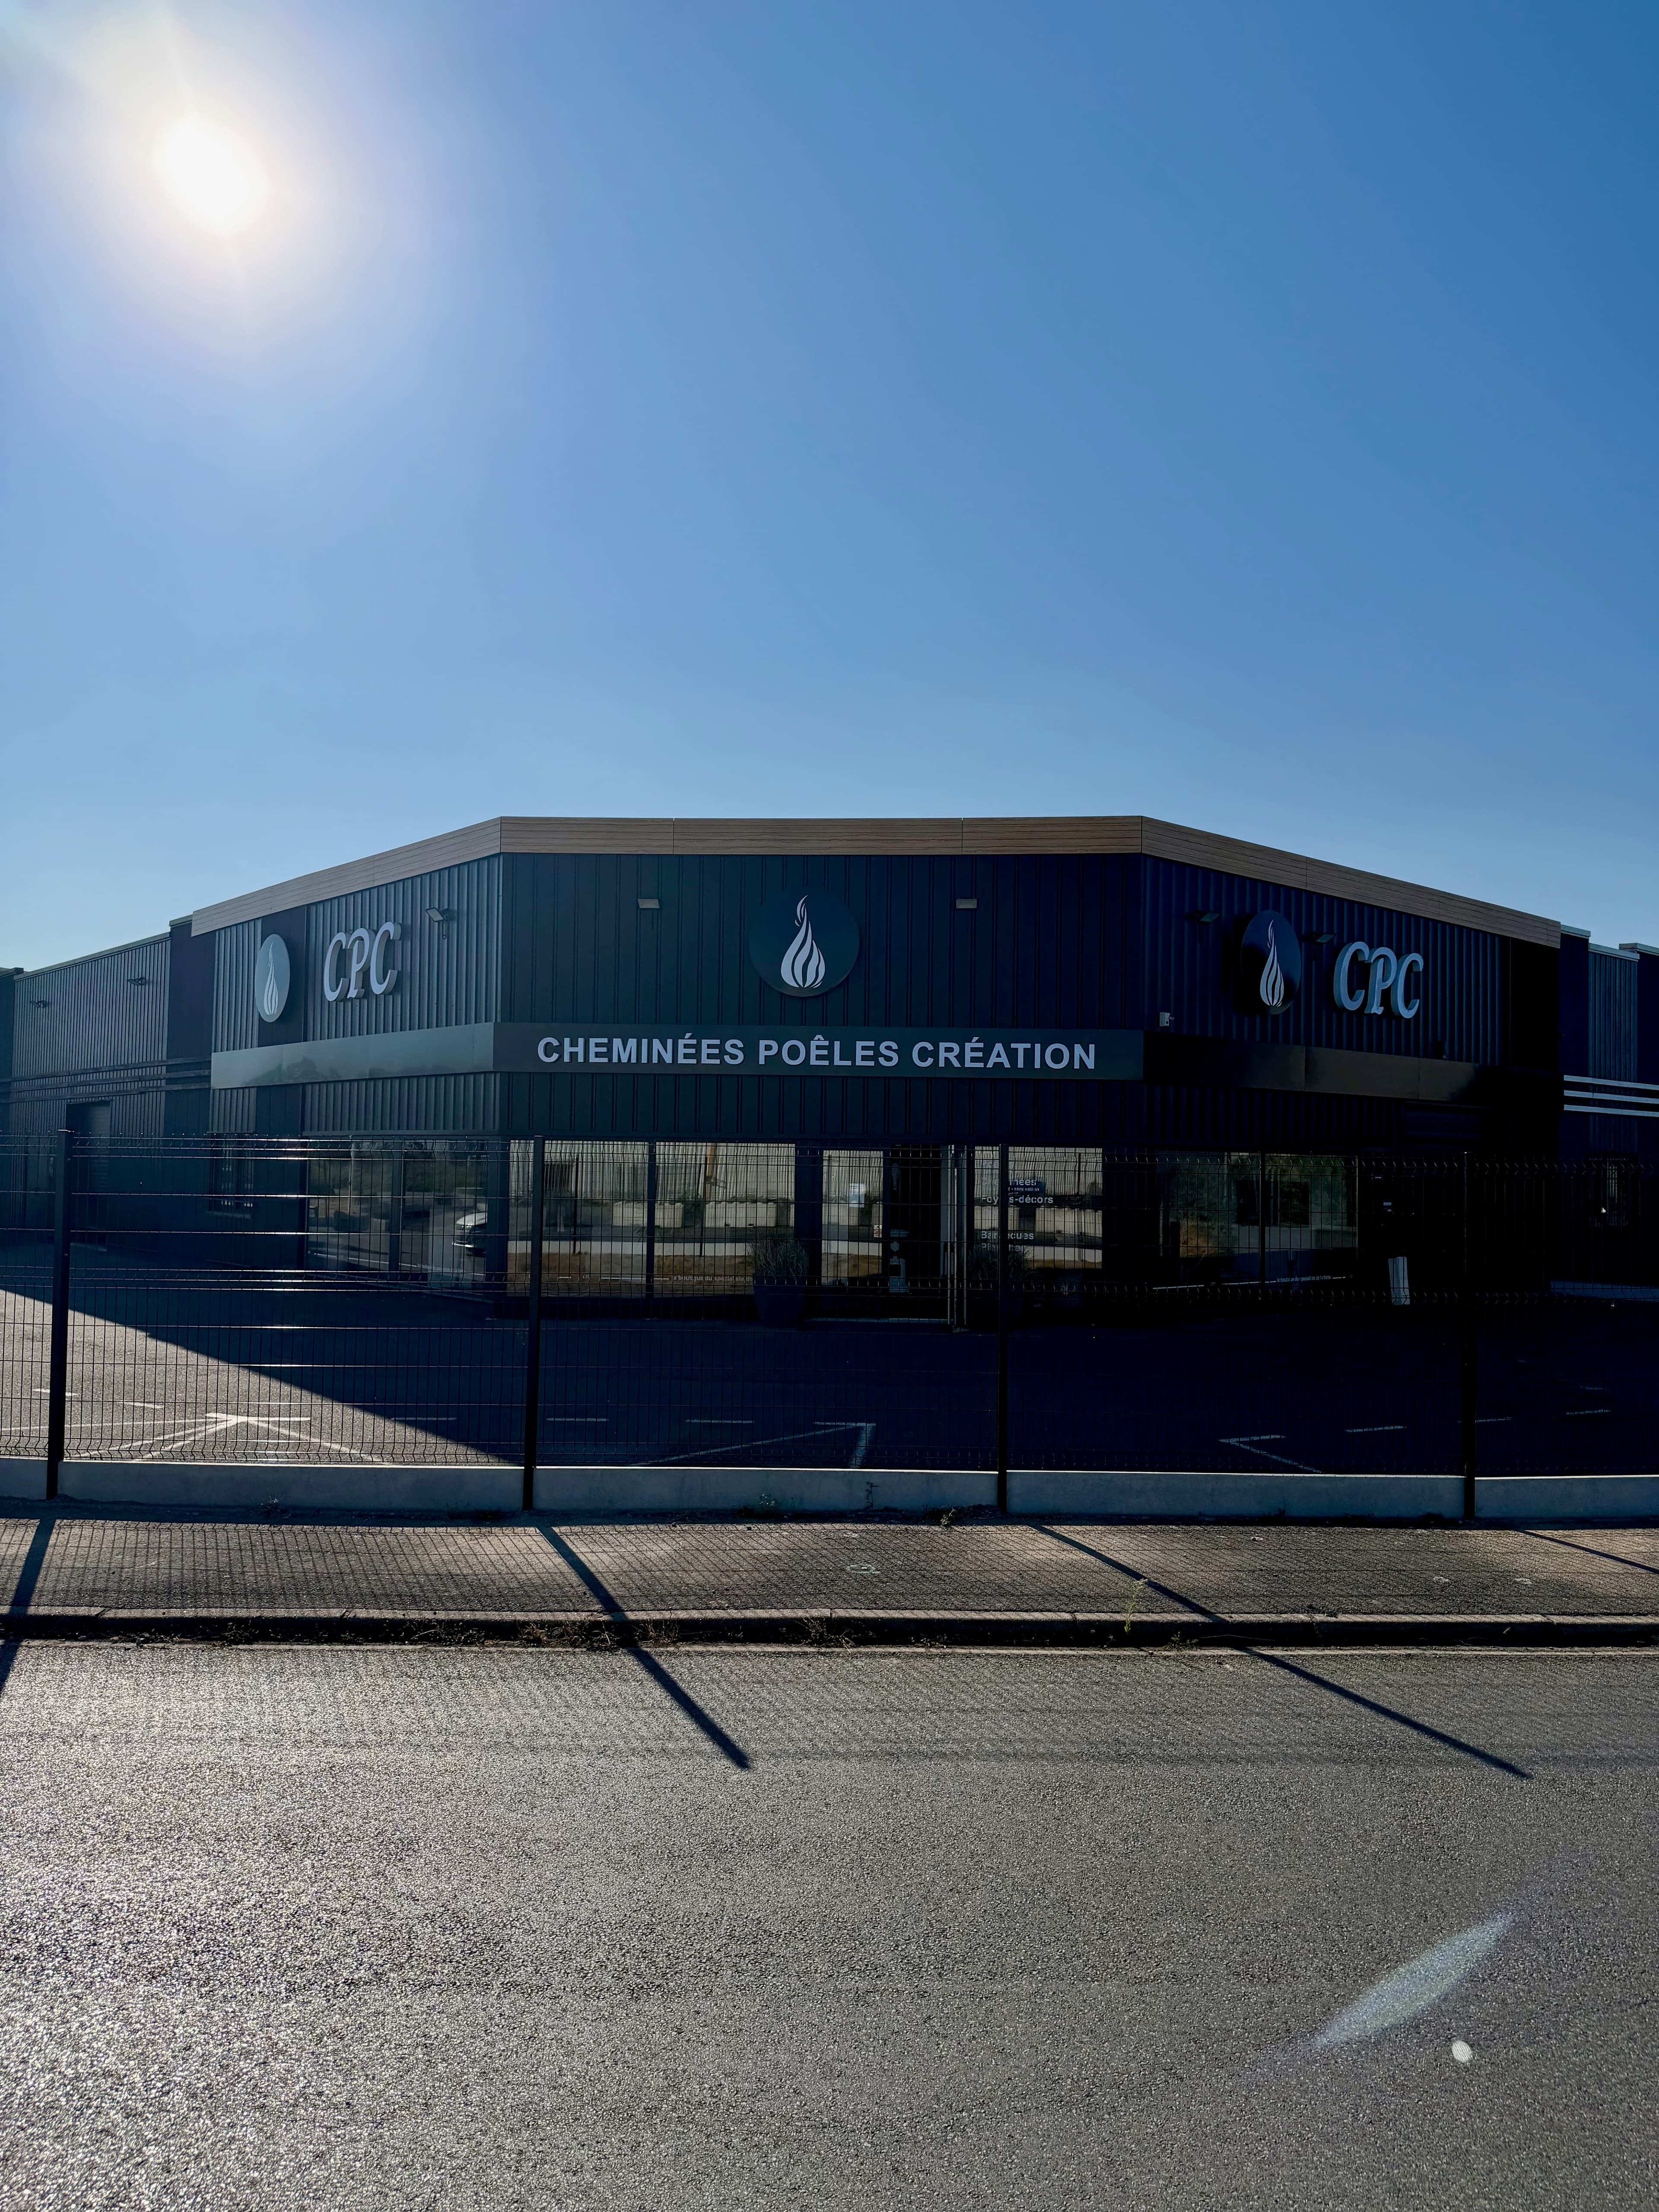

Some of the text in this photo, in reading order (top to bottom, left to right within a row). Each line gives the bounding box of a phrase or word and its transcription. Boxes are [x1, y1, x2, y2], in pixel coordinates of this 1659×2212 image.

[324, 922, 401, 1002] CPC
[1334, 941, 1424, 1019] CPC
[537, 1033, 1096, 1070] CHEMINÉES POÊLES CRÉATION
[982, 1195, 1053, 1205] Foys-décors
[981, 1230, 1034, 1239] Barcues
